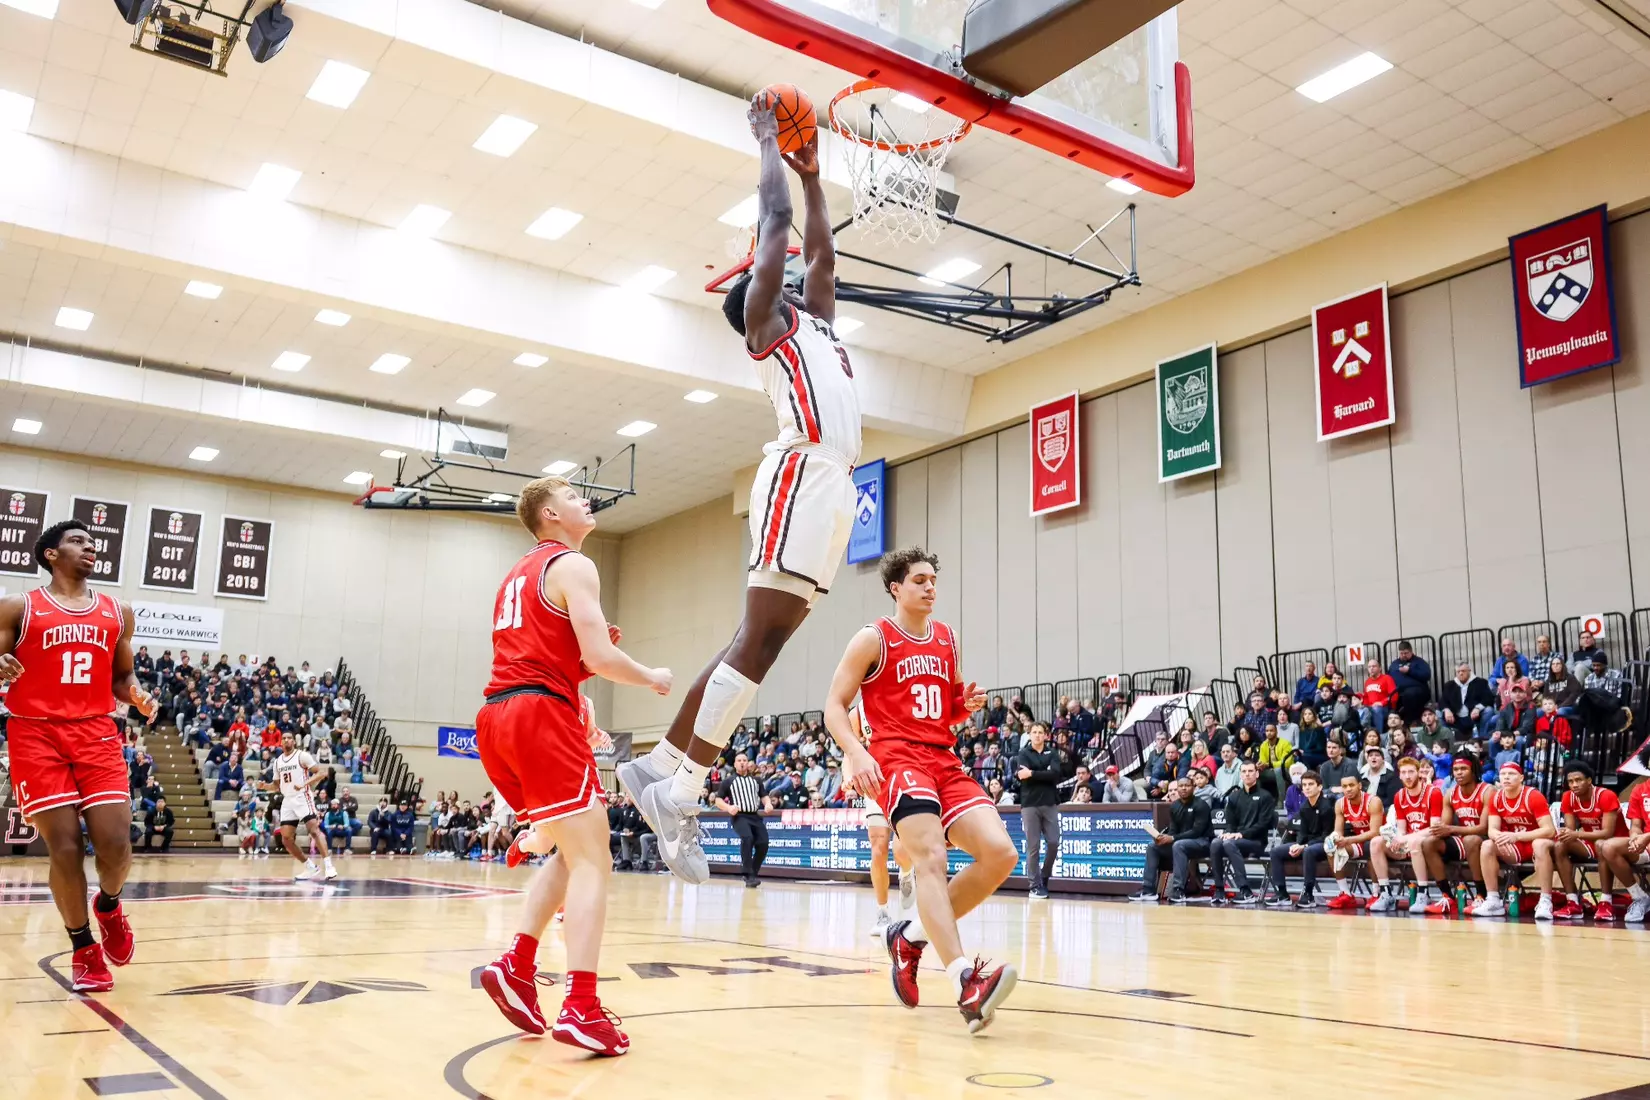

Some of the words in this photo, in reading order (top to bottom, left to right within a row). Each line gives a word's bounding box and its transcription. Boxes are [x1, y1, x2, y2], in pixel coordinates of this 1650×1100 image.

[1526, 329, 1608, 365] Pennsylvania
[1334, 396, 1375, 420] Harvard
[1167, 440, 1210, 461] Dartmouth
[1041, 479, 1067, 496] Cornell
[9, 515, 38, 525] BASKETBALL
[2, 527, 26, 543] NIT
[168, 534, 194, 543] BASKETBALL
[94, 538, 108, 553] BI
[161, 546, 184, 561] CIT
[0, 550, 31, 566] 003
[233, 554, 255, 569] CBI
[93, 560, 113, 575] 08
[152, 566, 187, 582] 2014
[226, 574, 259, 590] 2019
[495, 576, 527, 631] 31
[153, 612, 202, 622] LEXUS
[136, 625, 160, 634] EXUS
[177, 629, 219, 639] WARWICK
[1584, 618, 1602, 635] O
[42, 624, 109, 652] CORNELL
[251, 656, 259, 665] J
[1349, 647, 1361, 661] N
[60, 651, 93, 684] 12
[896, 654, 950, 684] CORNELL
[1108, 677, 1118, 689] M
[910, 683, 942, 719] 30
[283, 772, 292, 783] 21
[903, 770, 917, 787] C
[20, 780, 30, 801] C
[1061, 816, 1092, 831] STORE
[1096, 820, 1123, 829] SPORTS
[810, 837, 831, 849] TICKET
[838, 838, 858, 850] STORE
[1062, 840, 1092, 854] STORE
[1097, 843, 1123, 853] SPORTS
[1125, 844, 1148, 853] TICKE
[810, 856, 831, 868] TICKET
[838, 857, 857, 869] STORE
[1062, 862, 1092, 877] STORE
[1097, 867, 1124, 876] SPORTS
[1126, 868, 1144, 878] TICK
